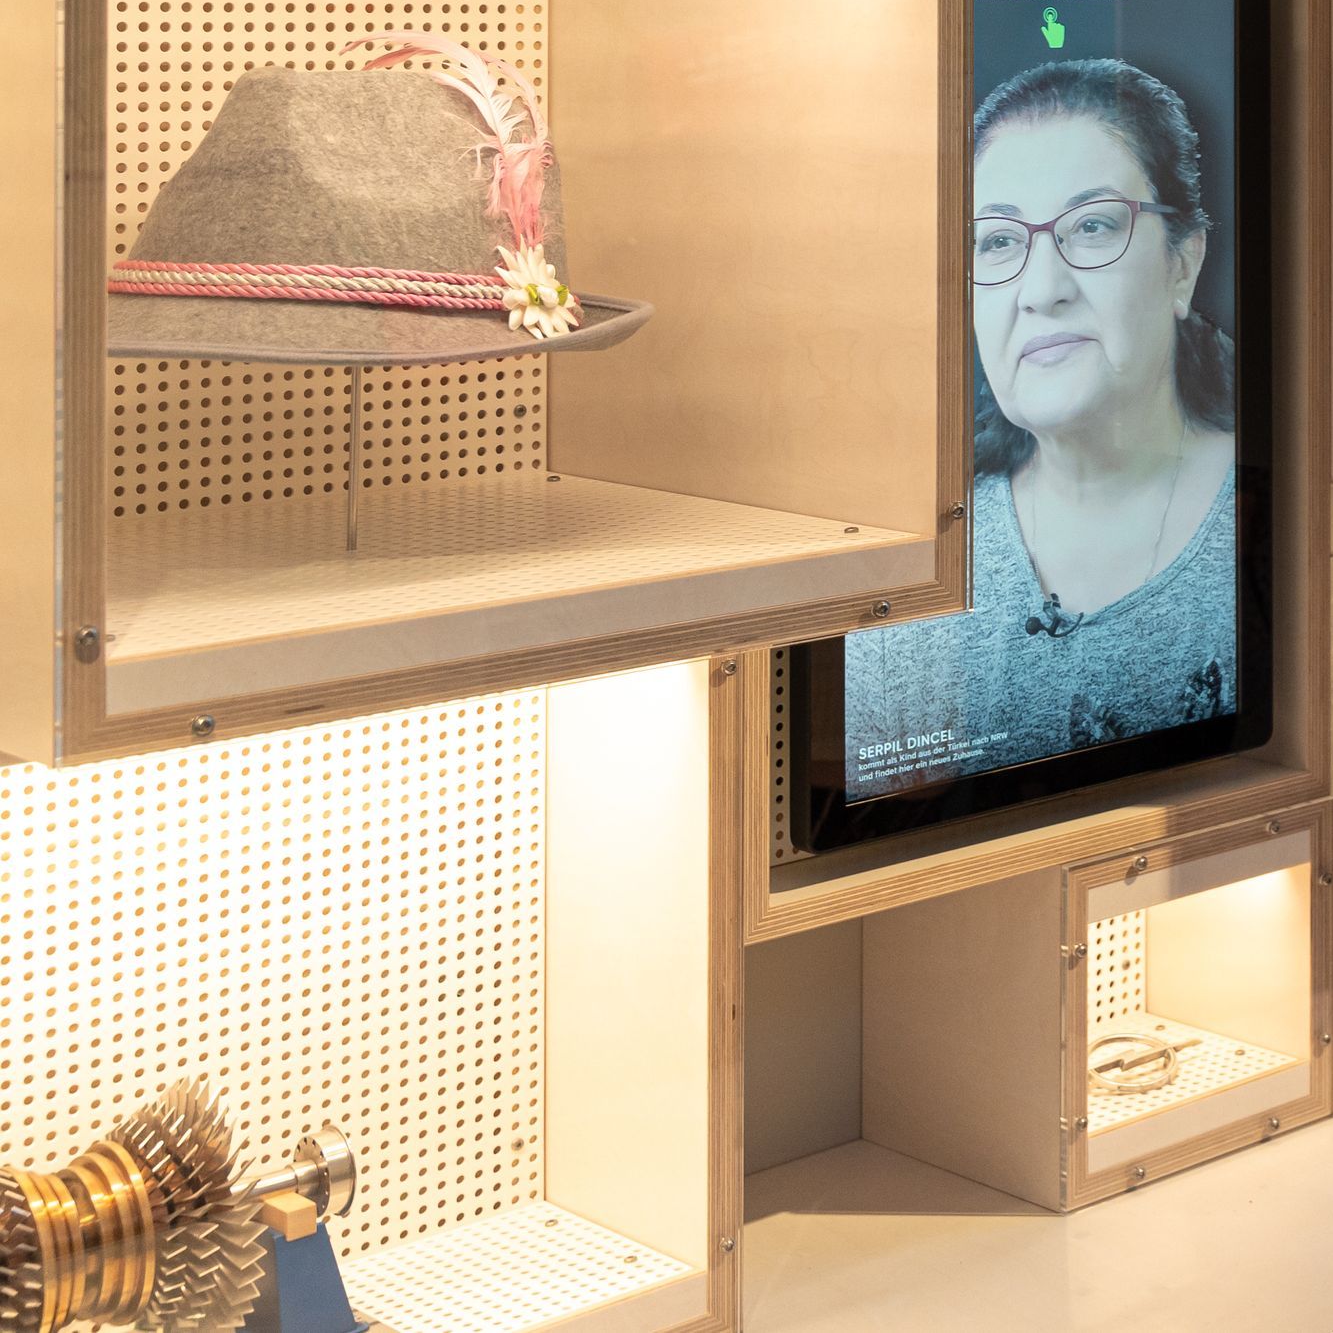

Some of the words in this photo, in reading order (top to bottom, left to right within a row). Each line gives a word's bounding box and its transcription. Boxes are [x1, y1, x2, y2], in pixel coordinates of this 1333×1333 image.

[858, 740, 903, 760] SERPIL
[907, 729, 955, 750] DINCEL
[858, 759, 885, 772] kommt
[886, 756, 898, 765] als
[900, 752, 917, 763] Kind
[918, 750, 932, 759] aus
[933, 746, 946, 756] der
[947, 740, 970, 753] Türkei
[971, 736, 989, 747] nach
[990, 731, 1009, 743] NRW
[858, 771, 874, 782] und
[875, 766, 898, 779] findet
[899, 762, 914, 773] hier
[915, 760, 928, 769] ein
[929, 756, 951, 767] neues
